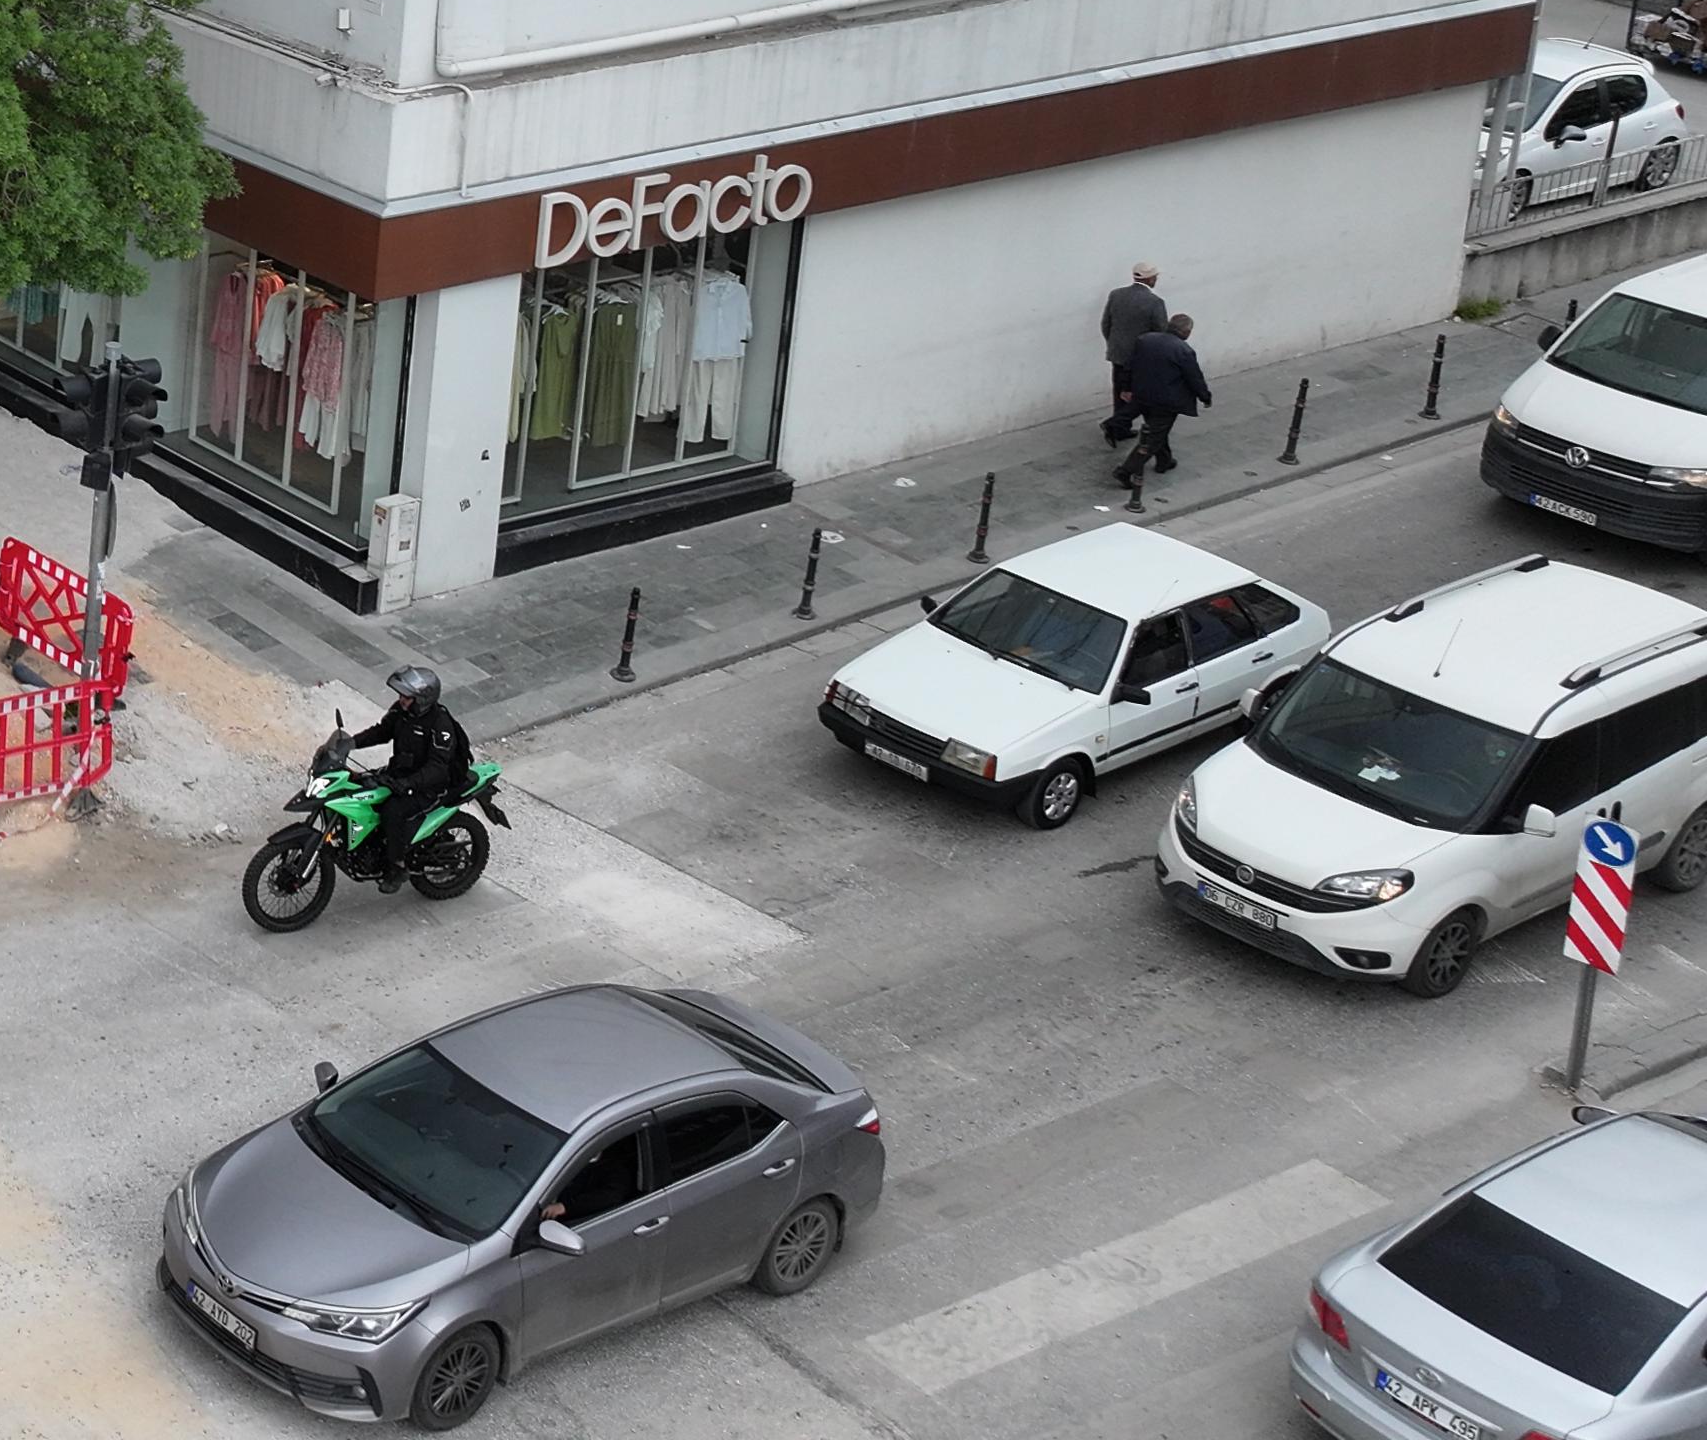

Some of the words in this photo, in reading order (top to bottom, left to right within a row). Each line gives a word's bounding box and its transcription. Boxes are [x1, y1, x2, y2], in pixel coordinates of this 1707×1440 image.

[535, 154, 813, 268] DeFacto
[1204, 887, 1219, 902] 06
[1224, 896, 1245, 915] CZR
[1251, 908, 1273, 926] 880
[192, 1288, 206, 1308] 42
[210, 1303, 229, 1326] AYD
[233, 1320, 254, 1346] 202
[1385, 1377, 1403, 1398] 42
[1412, 1394, 1440, 1420] APK
[1449, 1415, 1477, 1440] 495
